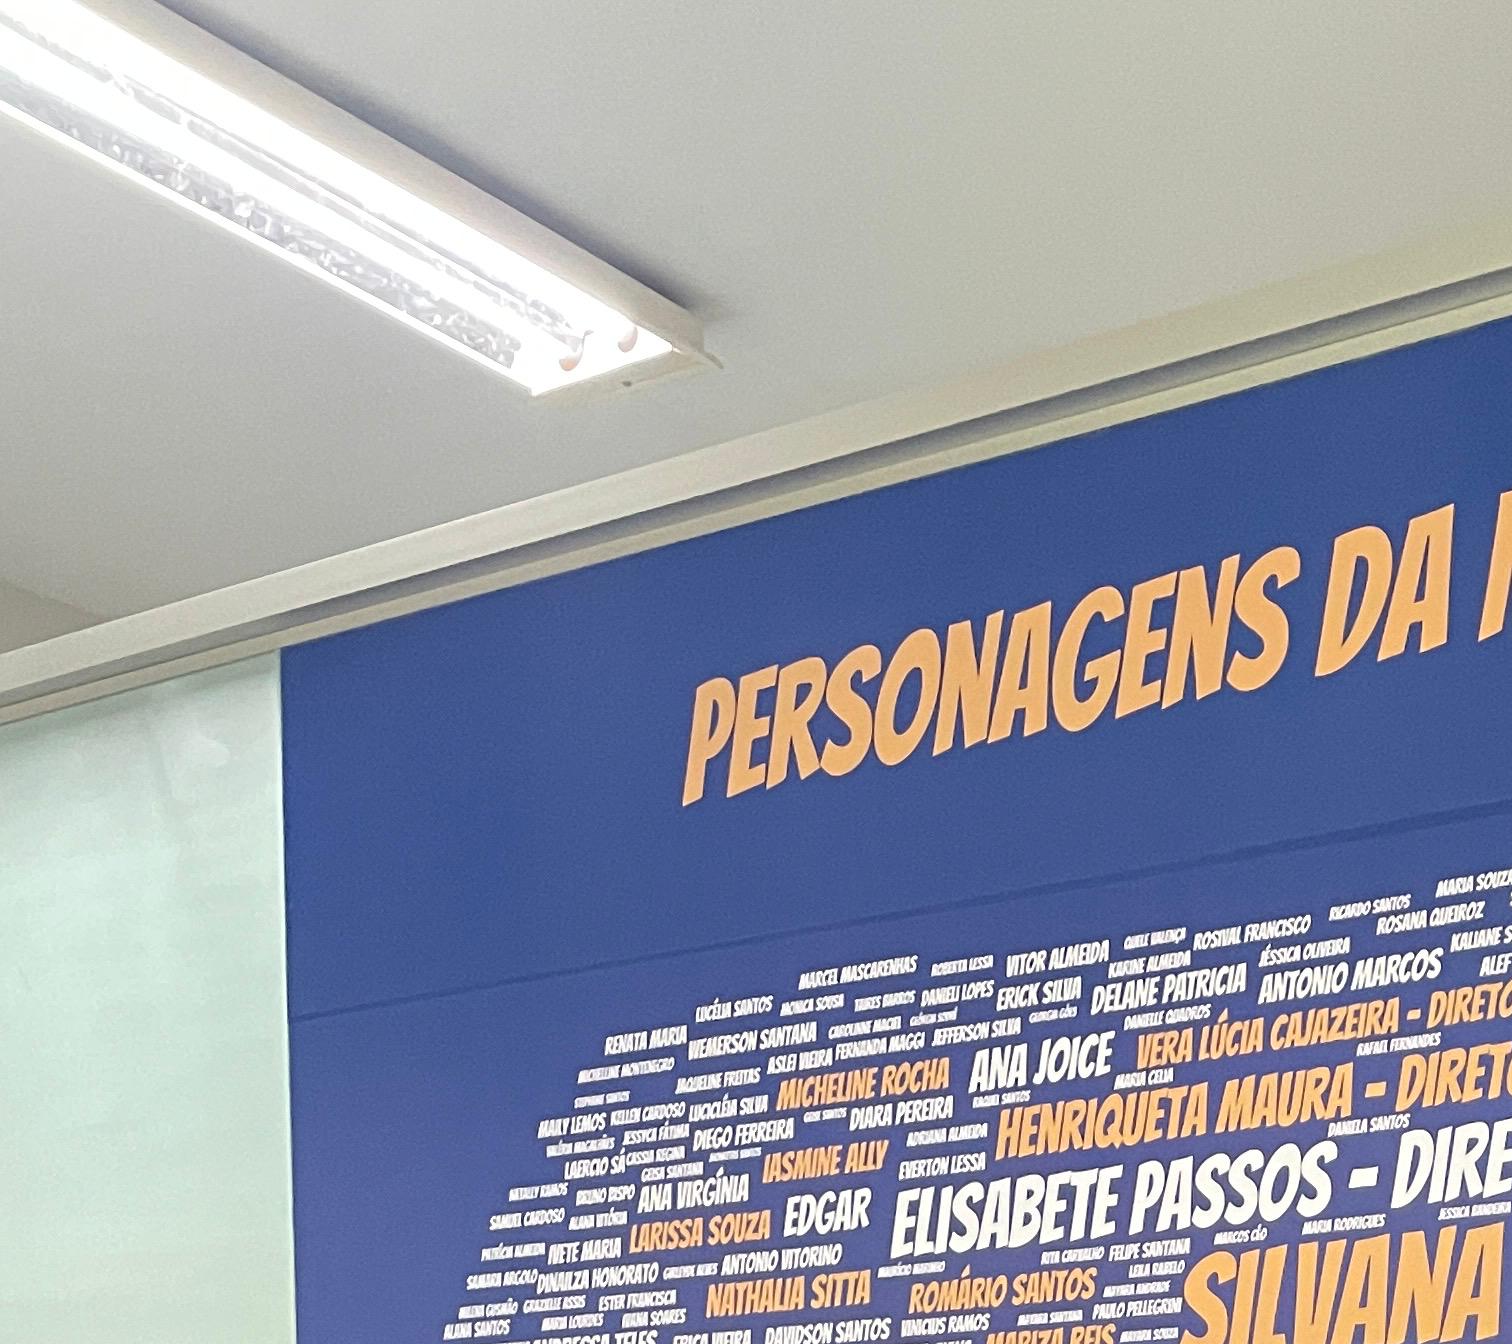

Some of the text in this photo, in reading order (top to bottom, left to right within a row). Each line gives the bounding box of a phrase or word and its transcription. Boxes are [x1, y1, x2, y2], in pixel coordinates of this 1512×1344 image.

[682, 546, 1290, 807] PERSONAGENS
[1314, 503, 1455, 677] DA
[1257, 947, 1443, 1005] ANTONIO MARCOS
[1137, 1027, 1193, 1069] VERA
[1198, 1008, 1264, 1062] LÚCIA
[1270, 997, 1399, 1050] CAJAZEIRA
[775, 1057, 950, 1112] MICHELINE ROCHA
[968, 1030, 1116, 1094] ANA JOICE
[995, 1082, 1209, 1161] HENRIQUETA
[1214, 1061, 1353, 1135] MAURA
[844, 1139, 890, 1174] ALLY
[637, 1167, 749, 1214] ANA VIRGÍNIA
[783, 1187, 872, 1237] EDGAR
[890, 1161, 1123, 1264] ELISABETE
[1128, 1140, 1338, 1237] PASSOS
[628, 1209, 771, 1255] LARISSA SOUZA
[705, 1269, 871, 1319] NATHALIA SITTA
[908, 1264, 1098, 1315] ROMÁRIO SANTOS
